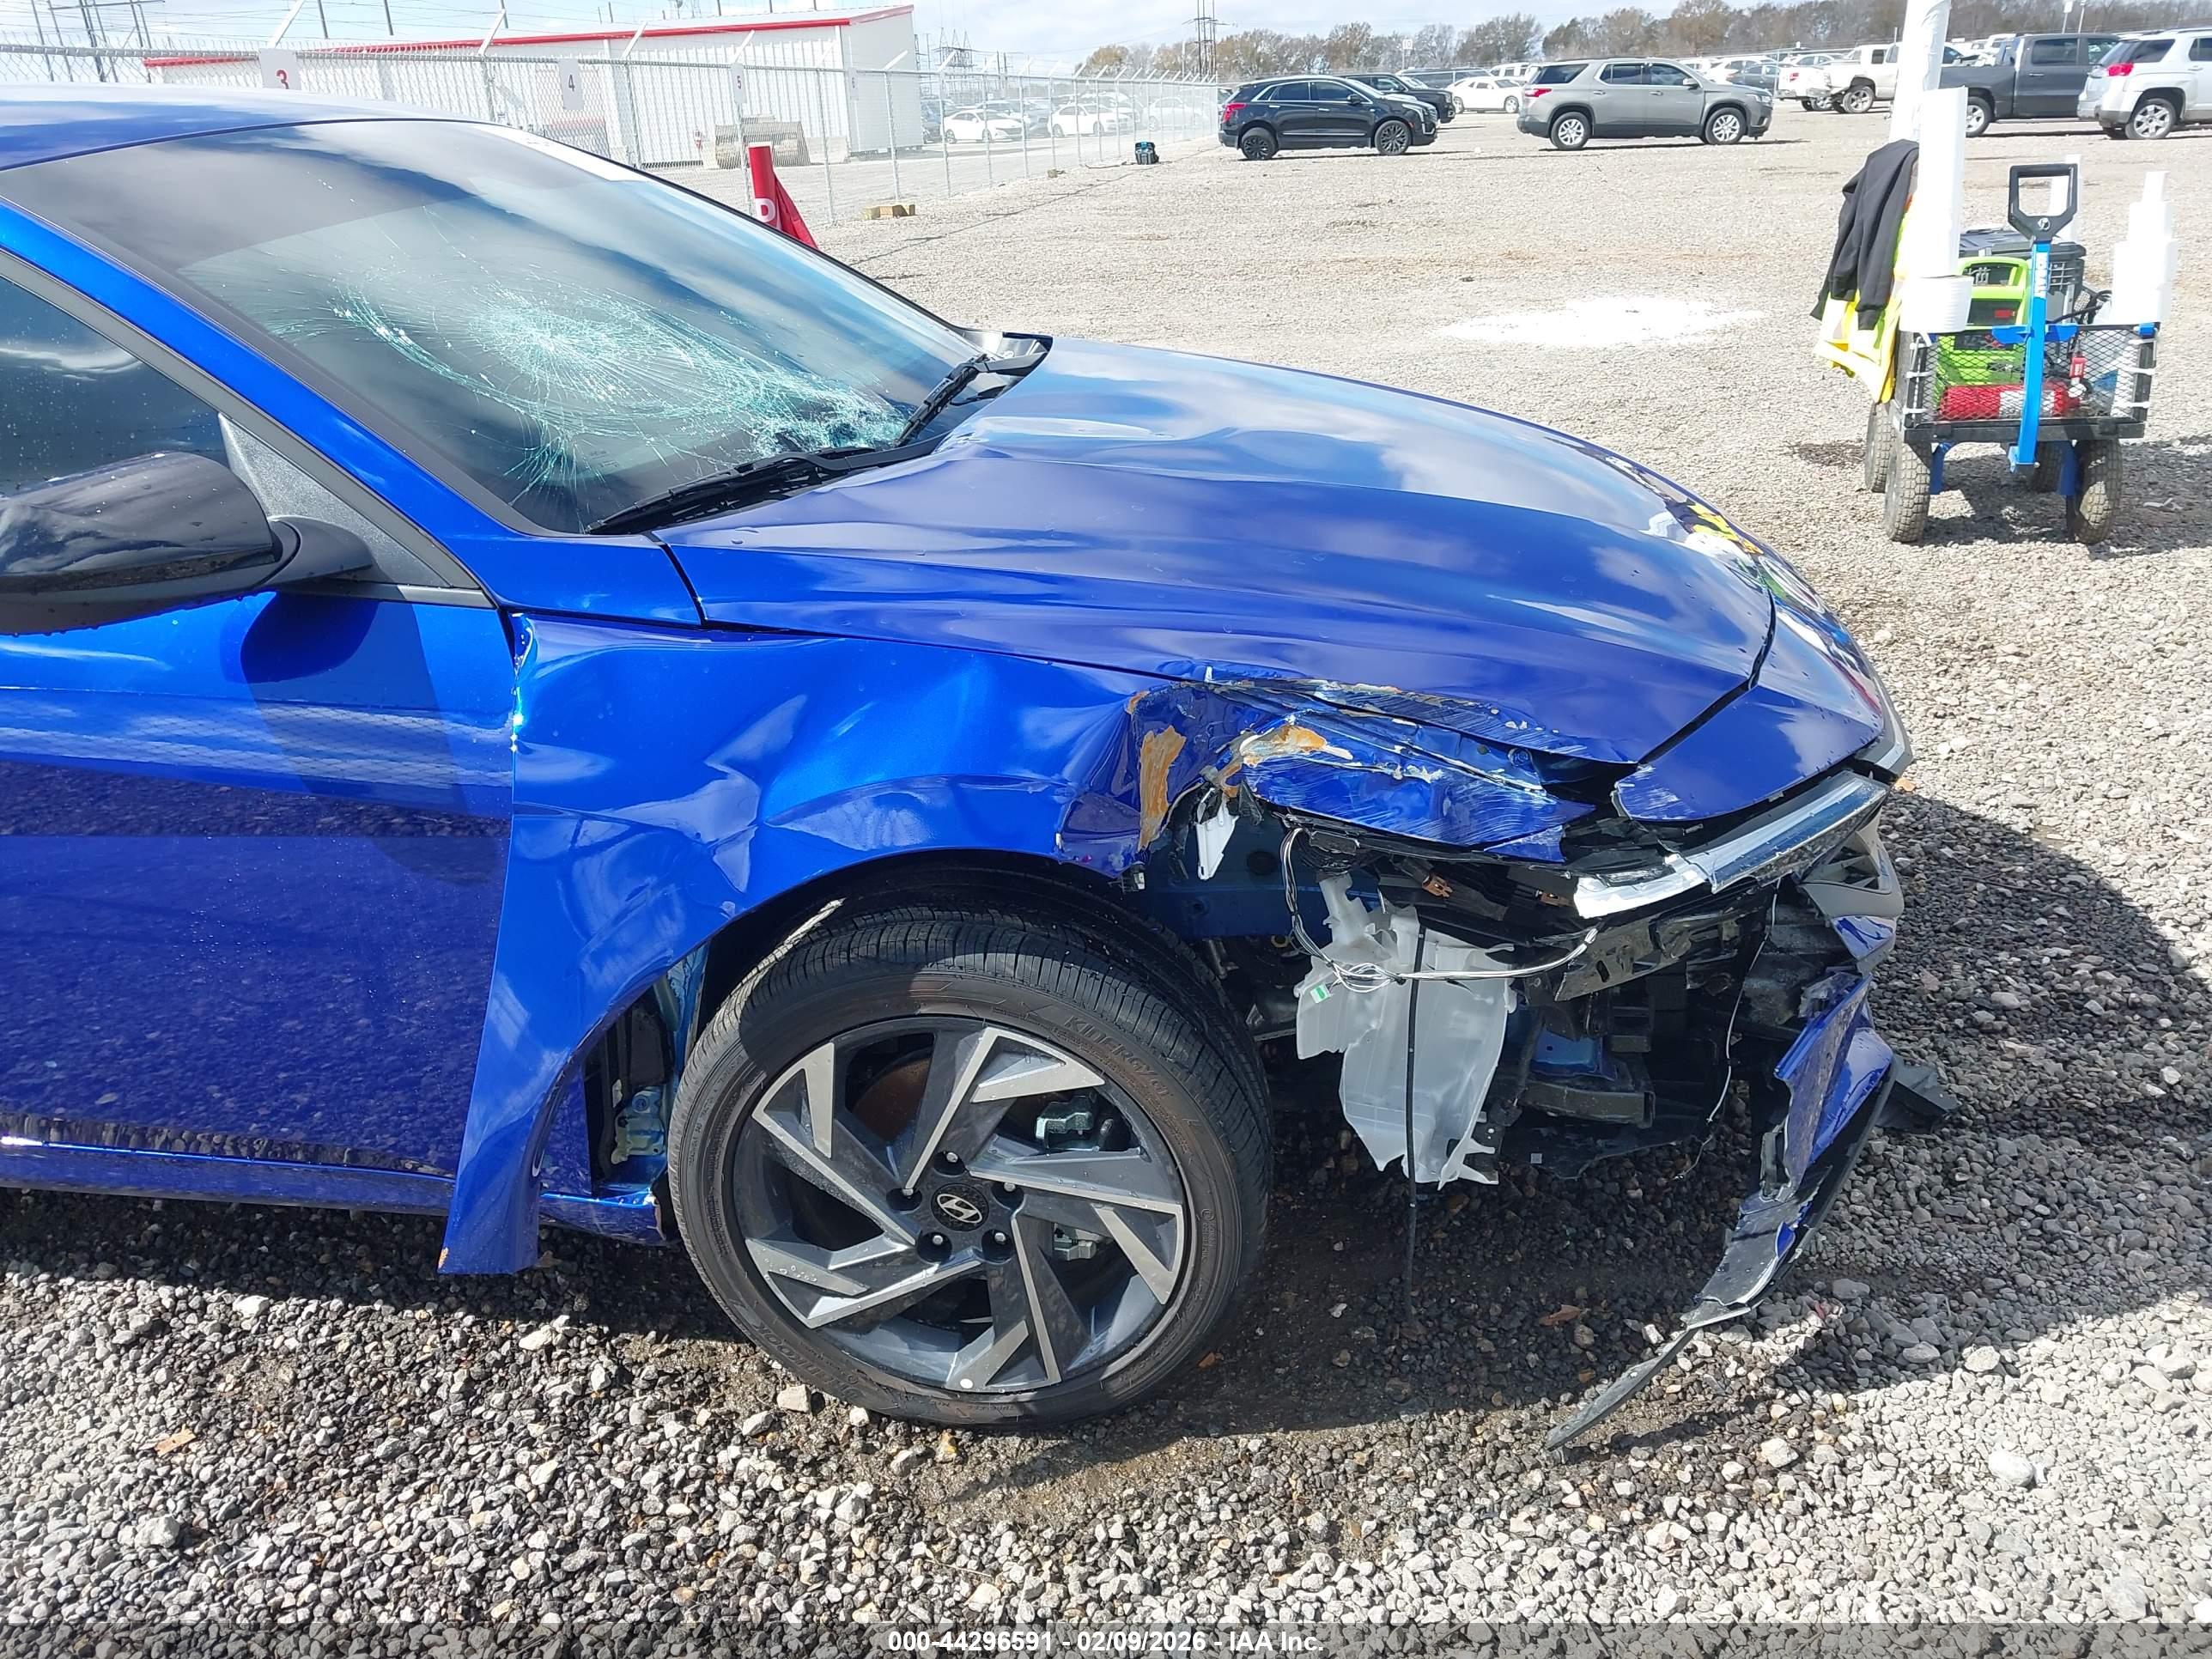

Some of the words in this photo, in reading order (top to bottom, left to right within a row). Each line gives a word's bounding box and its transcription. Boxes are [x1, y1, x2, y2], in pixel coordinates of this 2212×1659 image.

[276, 69, 289, 89] 3
[568, 74, 575, 92] 4
[736, 75, 742, 90] 5
